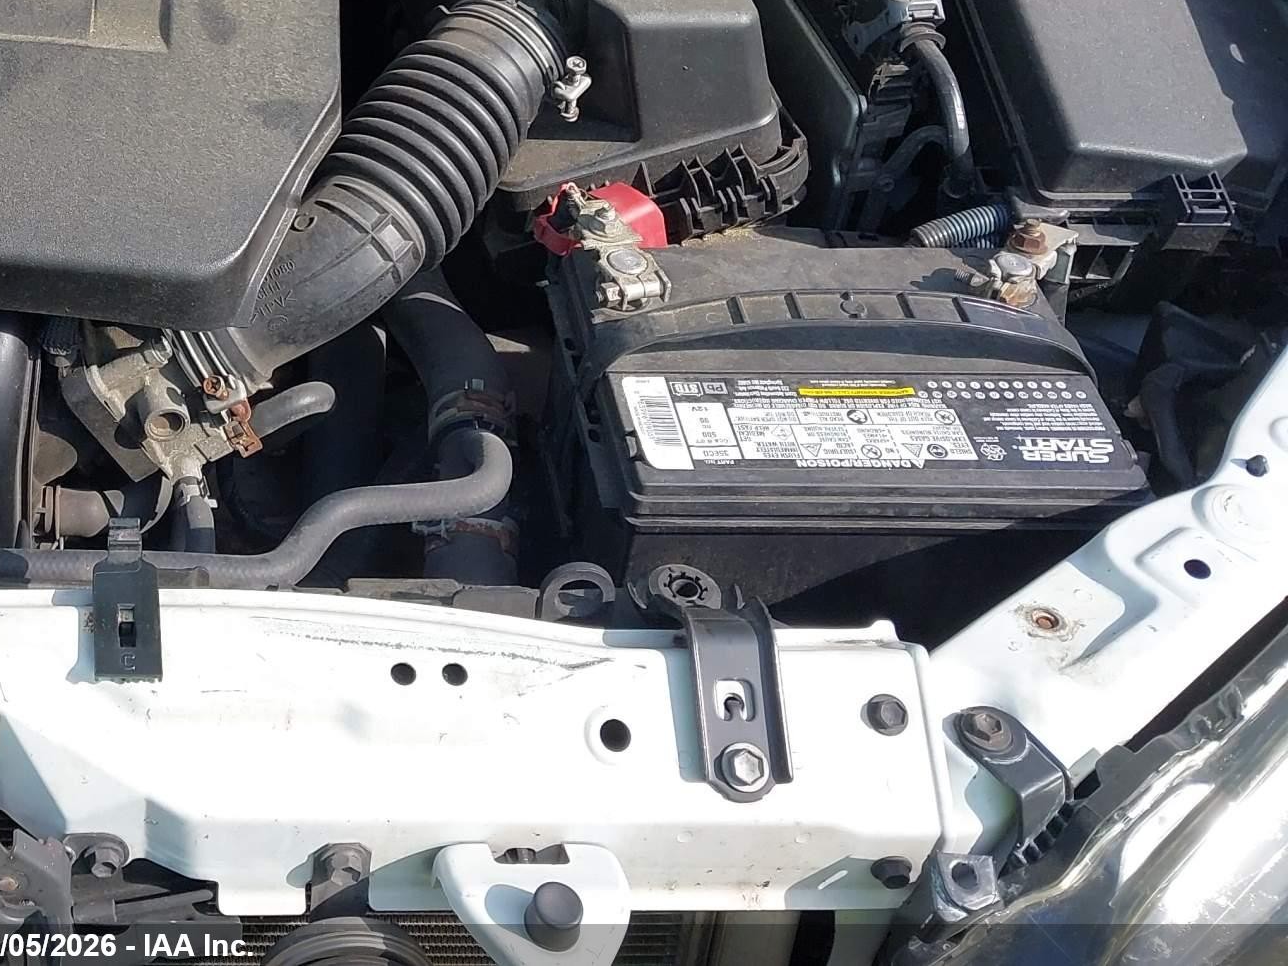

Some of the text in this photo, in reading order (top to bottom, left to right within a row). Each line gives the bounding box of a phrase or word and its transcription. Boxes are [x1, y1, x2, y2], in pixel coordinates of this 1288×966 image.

[706, 384, 724, 392] Pb
[1018, 438, 1114, 453] START
[1021, 450, 1110, 464] SUPER
[796, 459, 911, 468] DANGER/POISON
